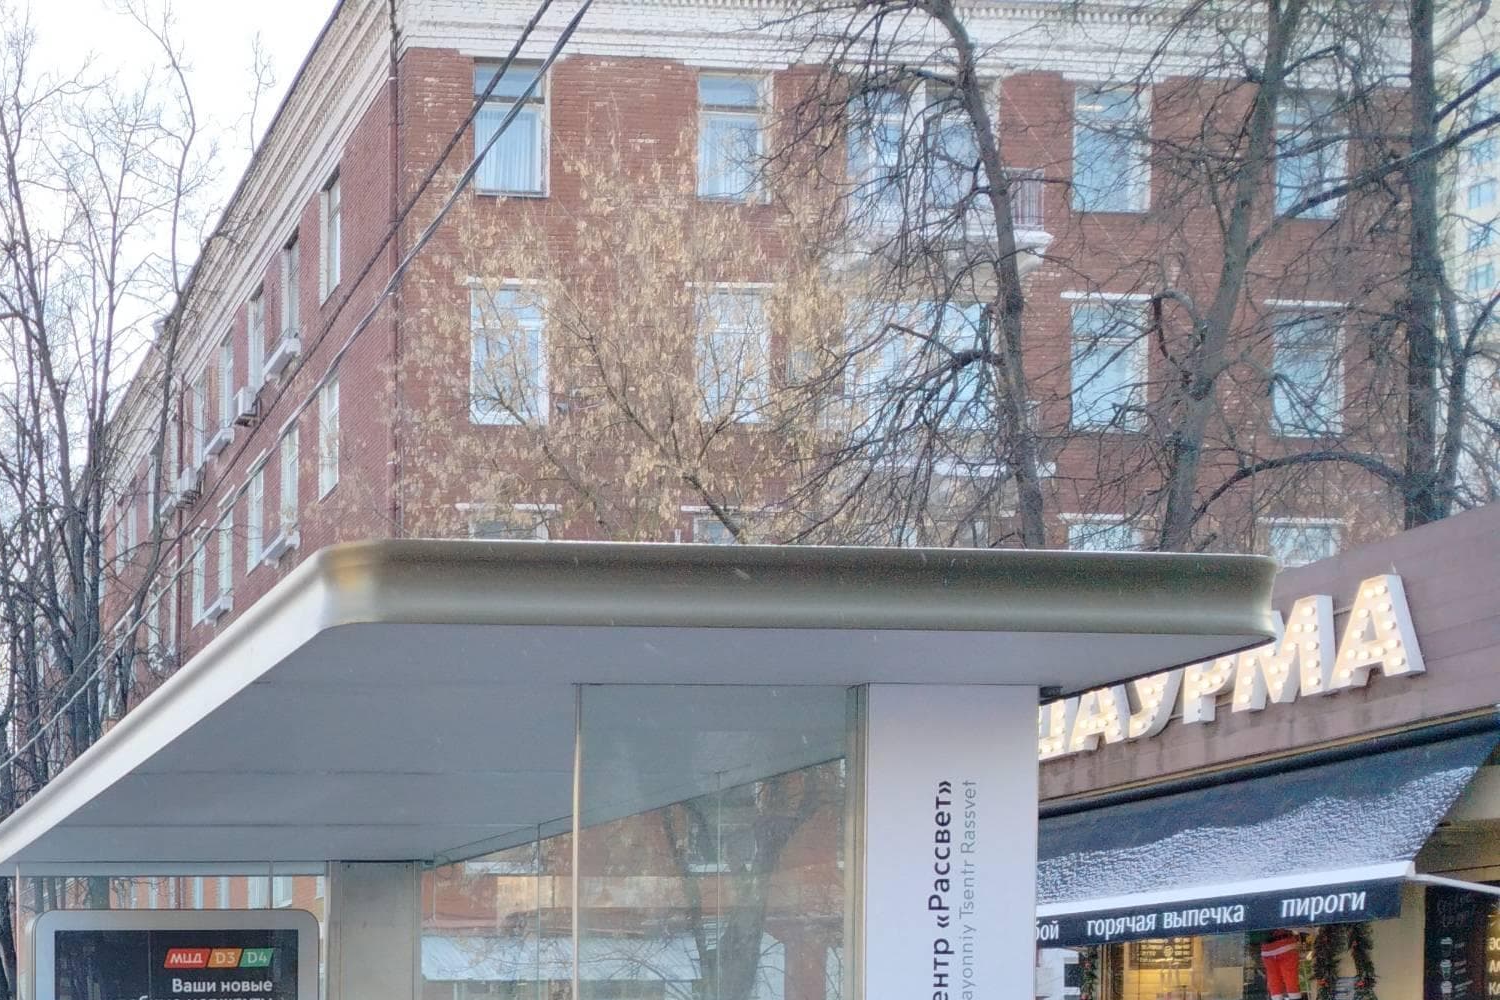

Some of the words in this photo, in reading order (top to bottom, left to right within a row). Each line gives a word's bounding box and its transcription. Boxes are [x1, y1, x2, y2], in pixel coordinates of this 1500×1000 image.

[960, 779, 977, 853] Rassvet
[927, 779, 952, 929] «Рассвет»
[959, 860, 975, 919] Tsentr
[1087, 912, 1156, 941] горячая
[1163, 903, 1245, 930] выпечка
[1281, 890, 1367, 922] пироги
[170, 952, 203, 964] МЦД
[215, 952, 236, 964] D3
[247, 951, 268, 964] D4
[172, 978, 217, 993] Ваши
[221, 979, 273, 993] новые
